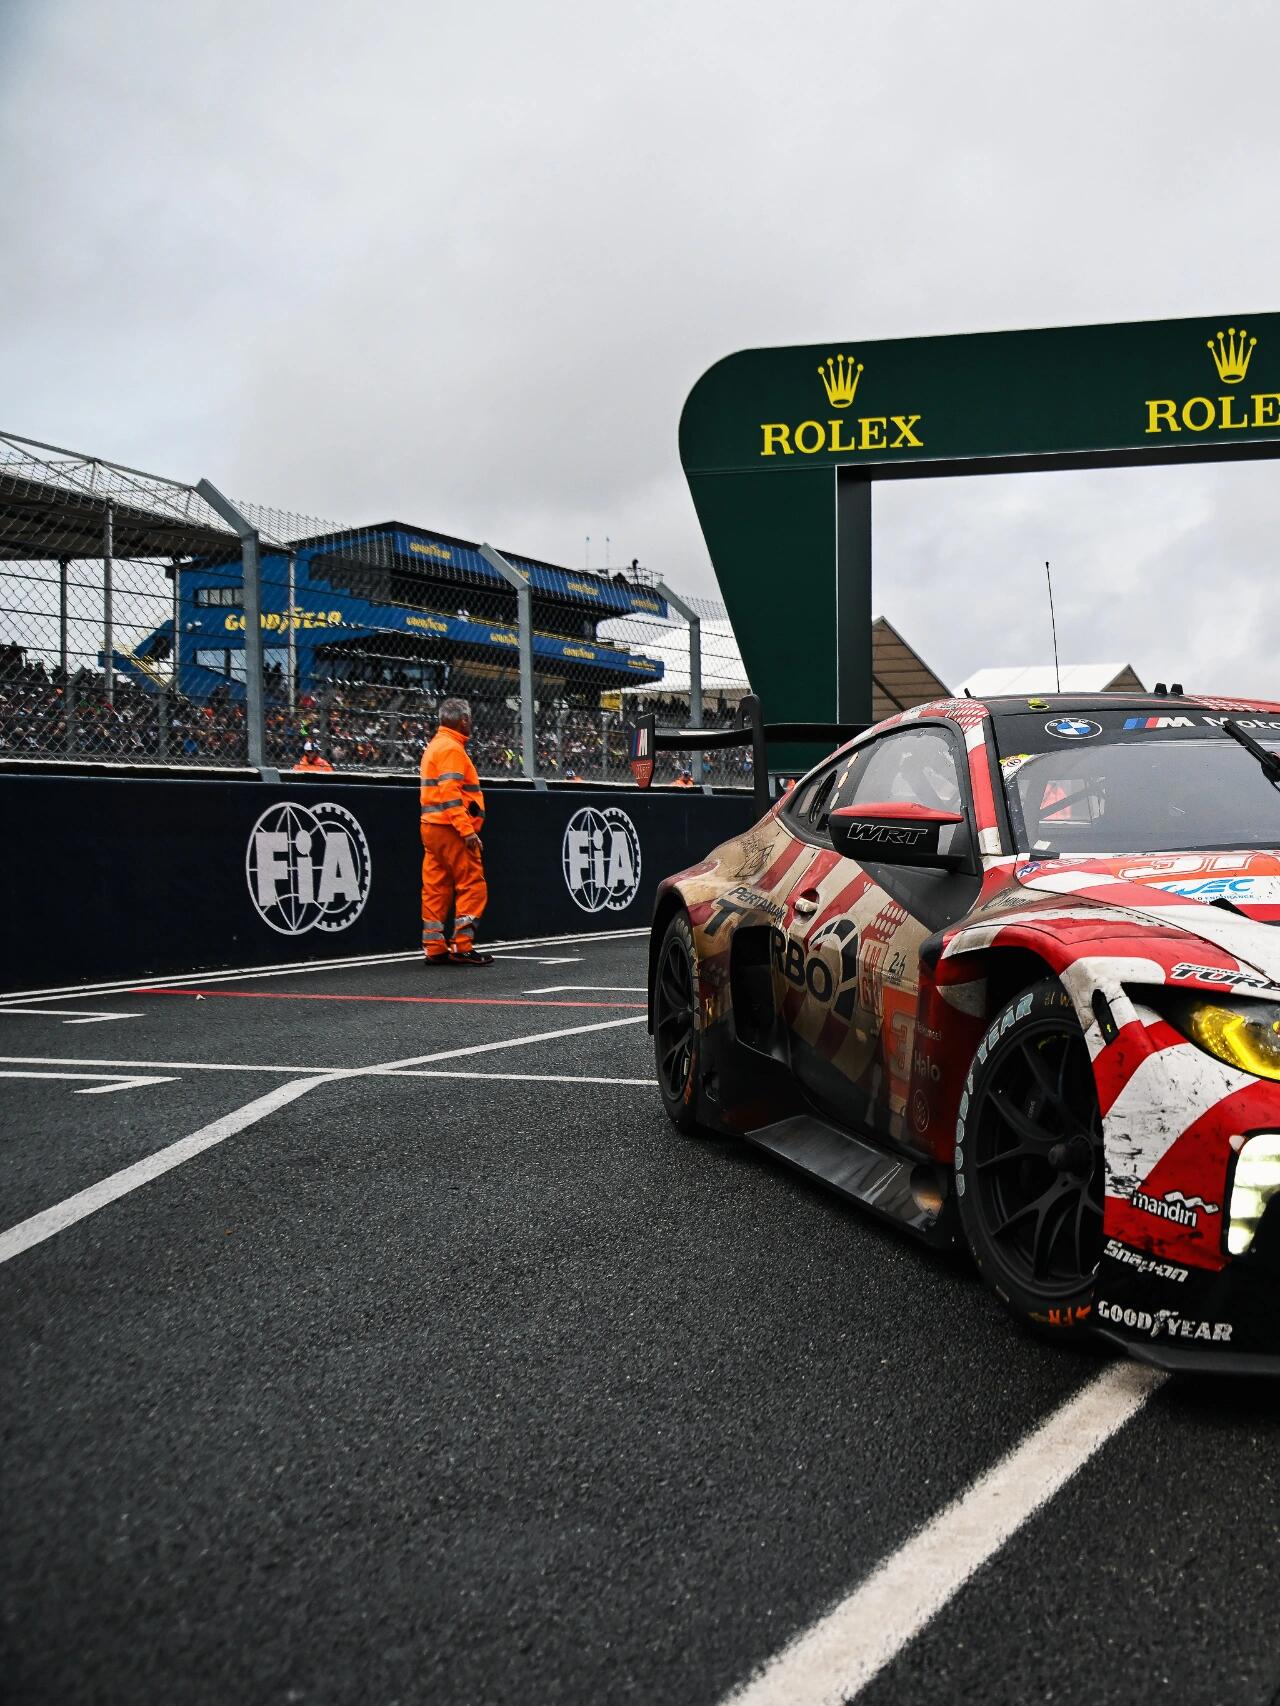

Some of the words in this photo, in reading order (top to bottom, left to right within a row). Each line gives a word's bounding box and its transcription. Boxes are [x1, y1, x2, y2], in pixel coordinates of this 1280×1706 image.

[760, 415, 924, 456] ROLEX
[847, 822, 928, 845] WRT
[703, 898, 834, 1003] TRBO
[1131, 1190, 1198, 1228] mandiri
[1097, 1299, 1233, 1341] GOODYEAR
